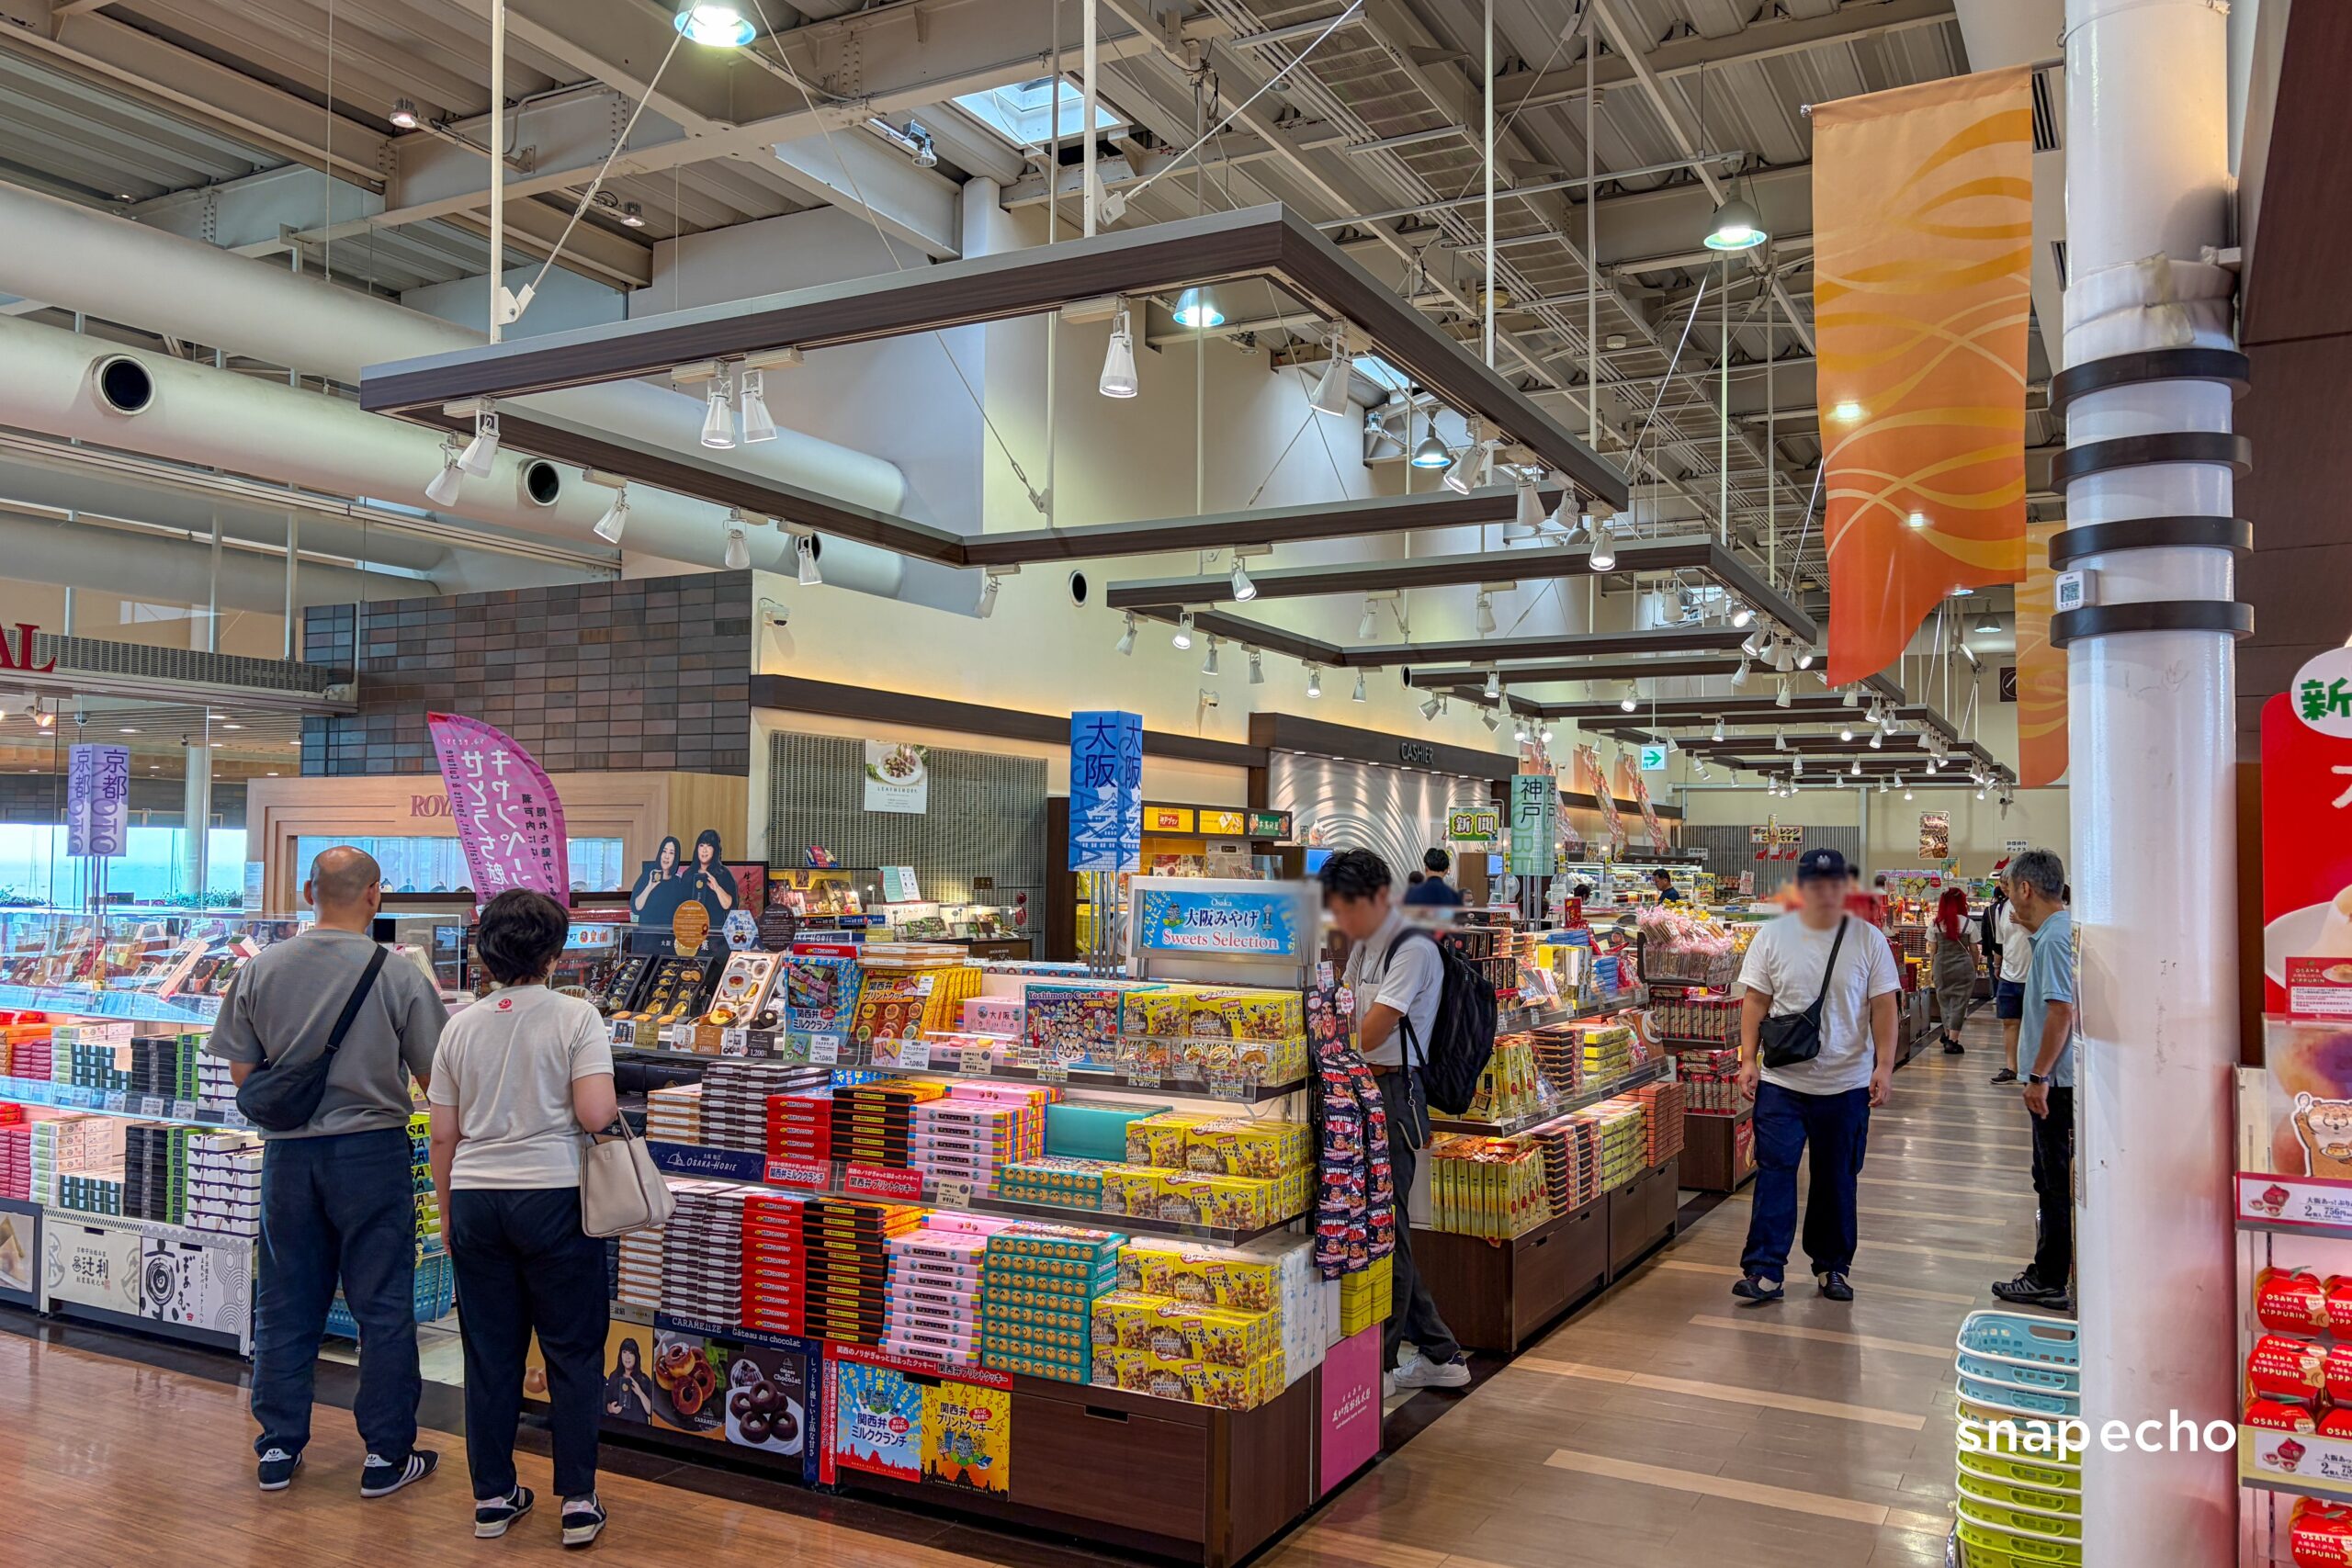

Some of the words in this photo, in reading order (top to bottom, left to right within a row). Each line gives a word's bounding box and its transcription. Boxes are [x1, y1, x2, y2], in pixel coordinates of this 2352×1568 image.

[1085, 716, 1116, 788] 大阪
[1125, 719, 1140, 789] 大阪
[1400, 742, 1433, 764] CASHIER
[75, 748, 90, 798] 京都
[103, 749, 128, 800] 京都
[1521, 778, 1542, 823] 神戸
[1211, 898, 1232, 907] Osaka
[1184, 908, 1260, 930] 大阪みやげ
[1162, 930, 1208, 945] Sweets
[1213, 931, 1279, 950] Selection
[1027, 991, 1072, 999] Yoshimoto
[797, 1010, 819, 1019] 関西弁
[793, 1019, 835, 1031] ミルククランチ
[768, 1168, 825, 1183] 関西弁ミルククランチ
[82, 1257, 108, 1280] 辻利
[2267, 1294, 2299, 1303] OSAKA
[2261, 1308, 2305, 1319] A!PPURIN
[732, 1328, 757, 1339] Gâteau
[770, 1336, 801, 1348] chocolat
[2258, 1352, 2292, 1362] OSAKA
[774, 1374, 801, 1384] Chocolat
[2252, 1366, 2299, 1378] A!PPURIN
[940, 1402, 968, 1416] 関西弁
[857, 1413, 888, 1428] 関西弁
[936, 1415, 994, 1433] プリントクッキー
[2253, 1417, 2287, 1427] OSAKA
[852, 1426, 907, 1448] ミルククランチ
[2301, 1533, 2335, 1543] OSAKA
[2295, 1547, 2341, 1560] A!PPURIN
